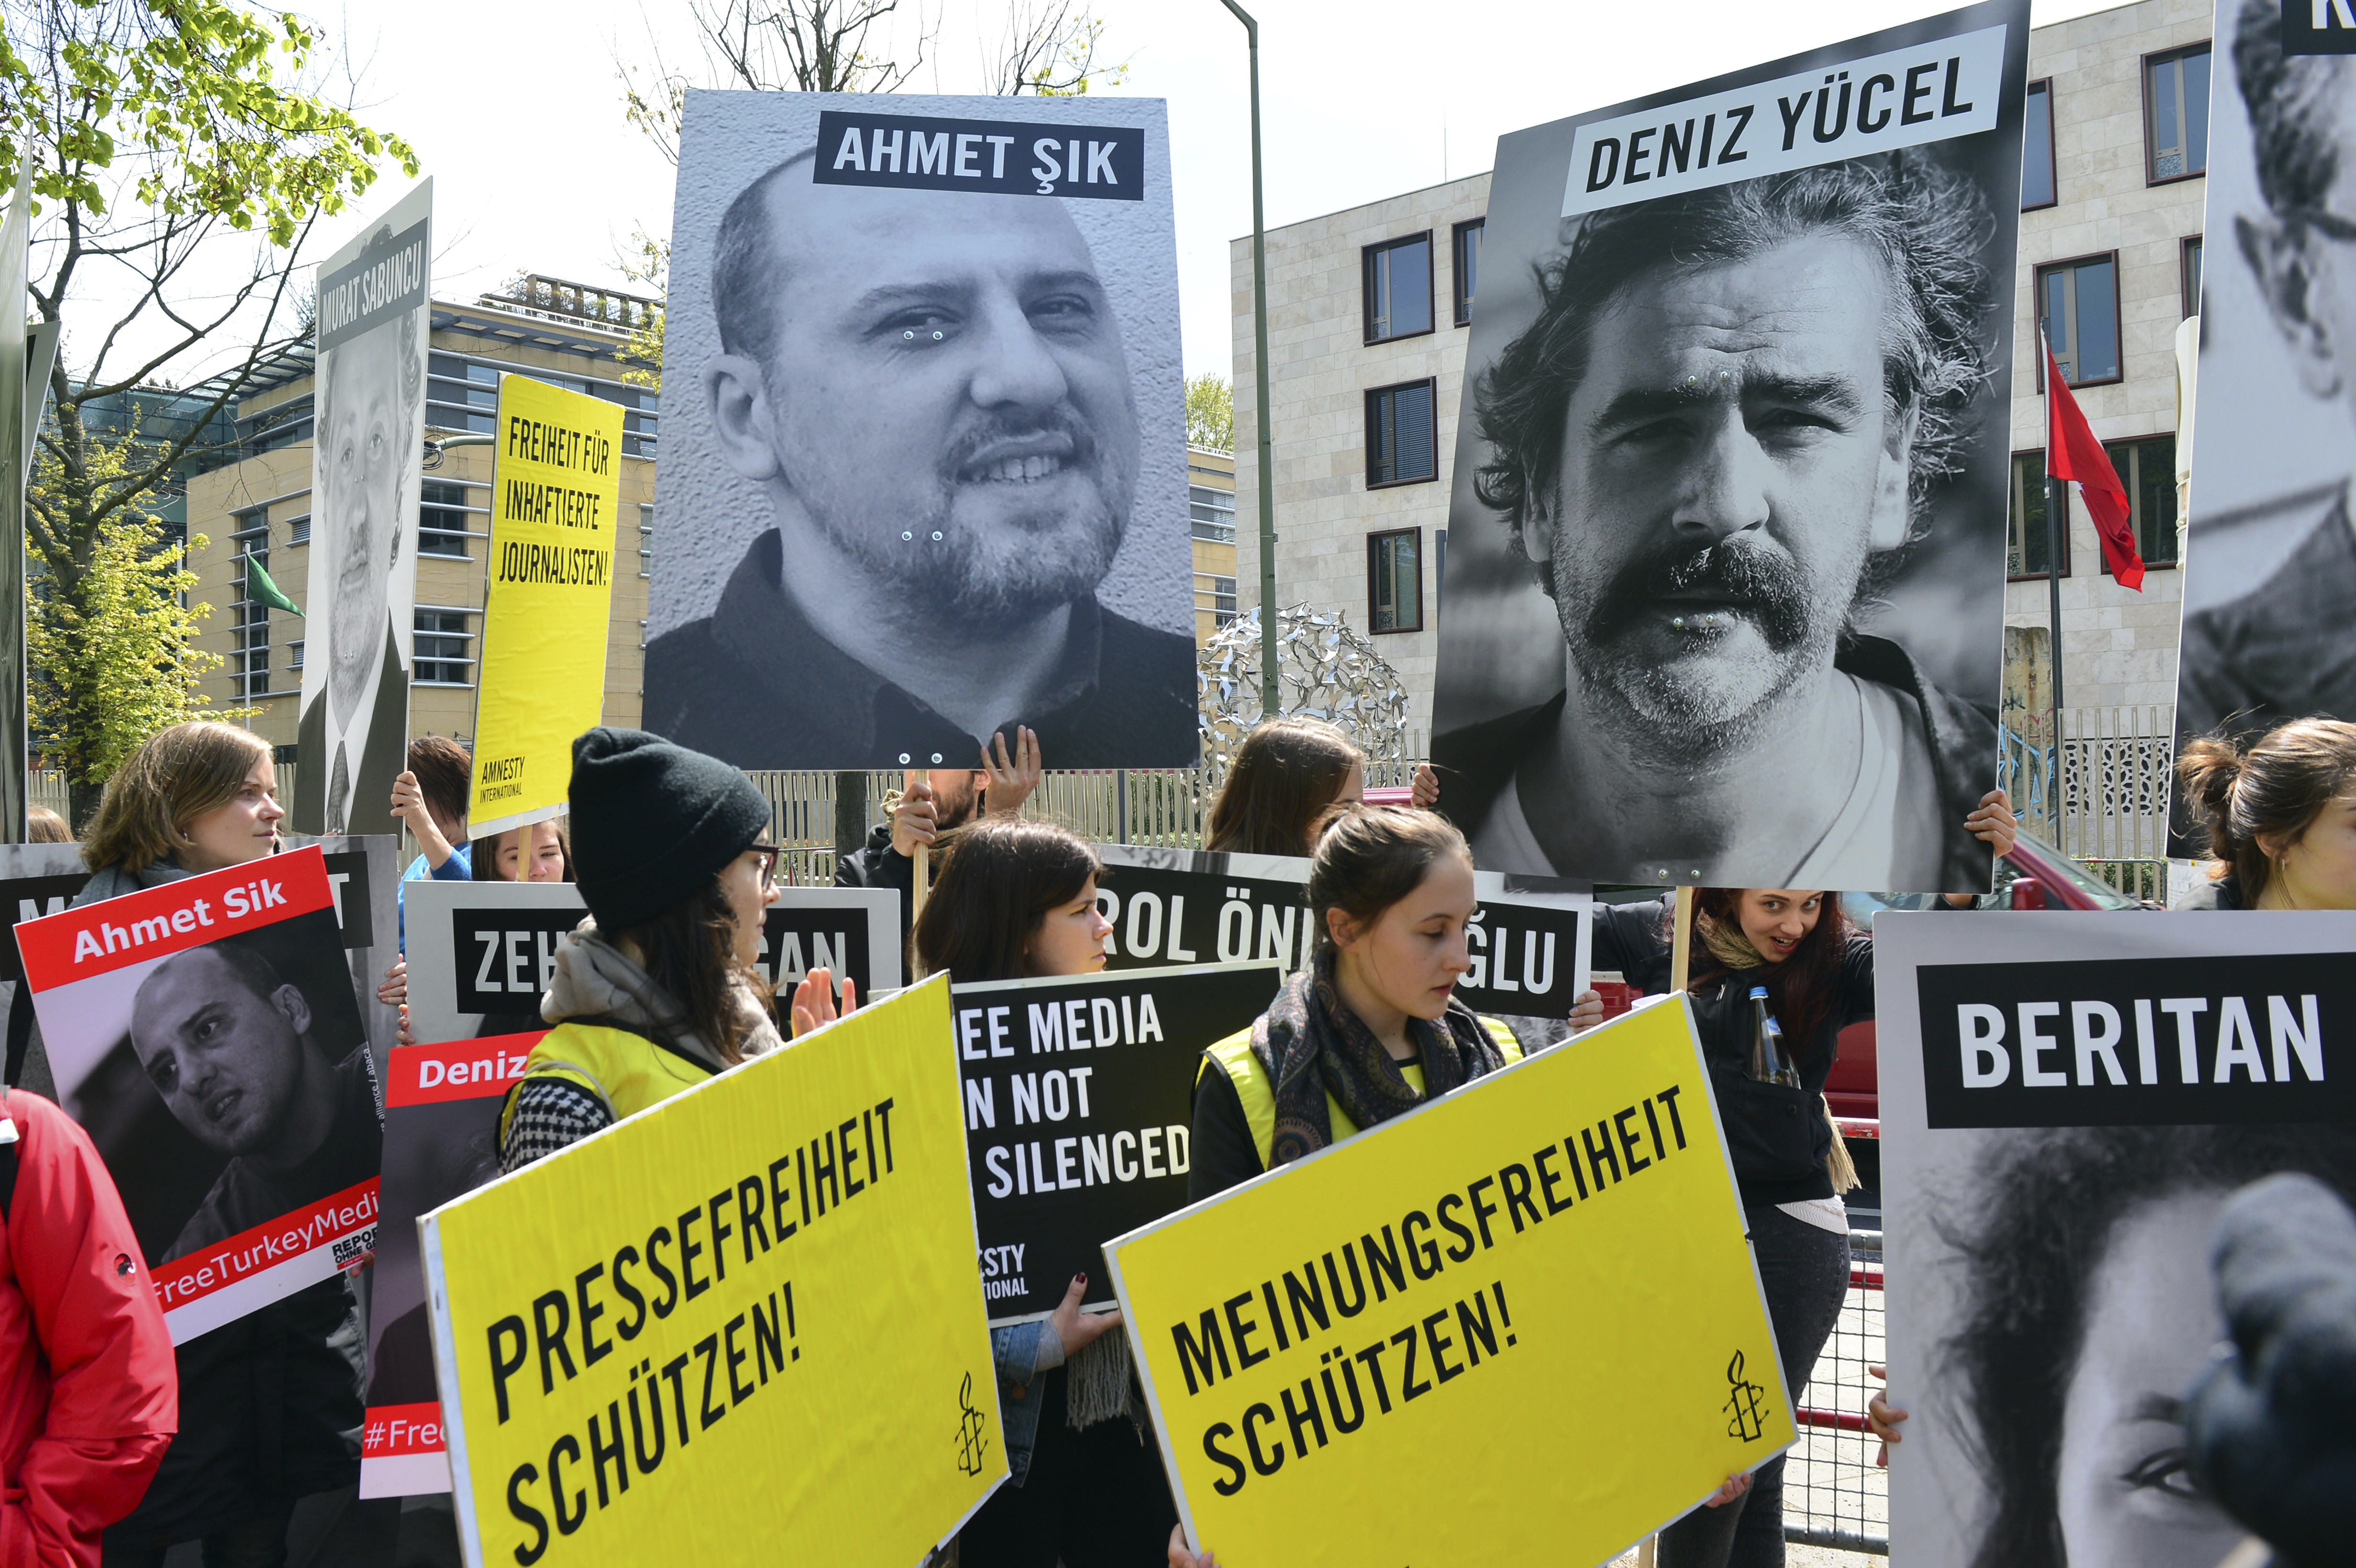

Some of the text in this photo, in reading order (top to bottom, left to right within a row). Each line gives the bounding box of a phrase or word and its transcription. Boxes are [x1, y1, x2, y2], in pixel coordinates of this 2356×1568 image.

[1586, 56, 1973, 193] DENIZ YÜCEL
[833, 127, 1118, 194] AHMET ŞIK
[323, 240, 422, 336] MURAT SABUNCU
[509, 416, 609, 476] FREIHEIT FÜR
[505, 479, 600, 530] INHAFTIERTE
[499, 542, 608, 586] JOURNALISTEN!
[480, 783, 522, 804] INTERNATIONAL
[481, 756, 525, 784] AMNESTY
[74, 899, 214, 963] Ahmet
[223, 878, 287, 918] Sik
[1028, 994, 1164, 1054] MEDIA
[1957, 994, 2324, 1089] BERITAN
[363, 1048, 375, 1075] abaca
[419, 1051, 527, 1089] Deniz
[1011, 1067, 1093, 1125] NOT
[985, 1124, 1190, 1198] SILENCED
[335, 1245, 362, 1263] OHNE
[486, 1097, 894, 1426] PRESSEFREIHEIT
[980, 1243, 1025, 1277] STY
[1170, 1085, 1687, 1396] MEINUNGSFREIHEIT
[983, 1277, 1029, 1300] IONAL
[1202, 1280, 1518, 1497] SCHÜTZEN!
[506, 1280, 801, 1567] SCHÜTZEN!
